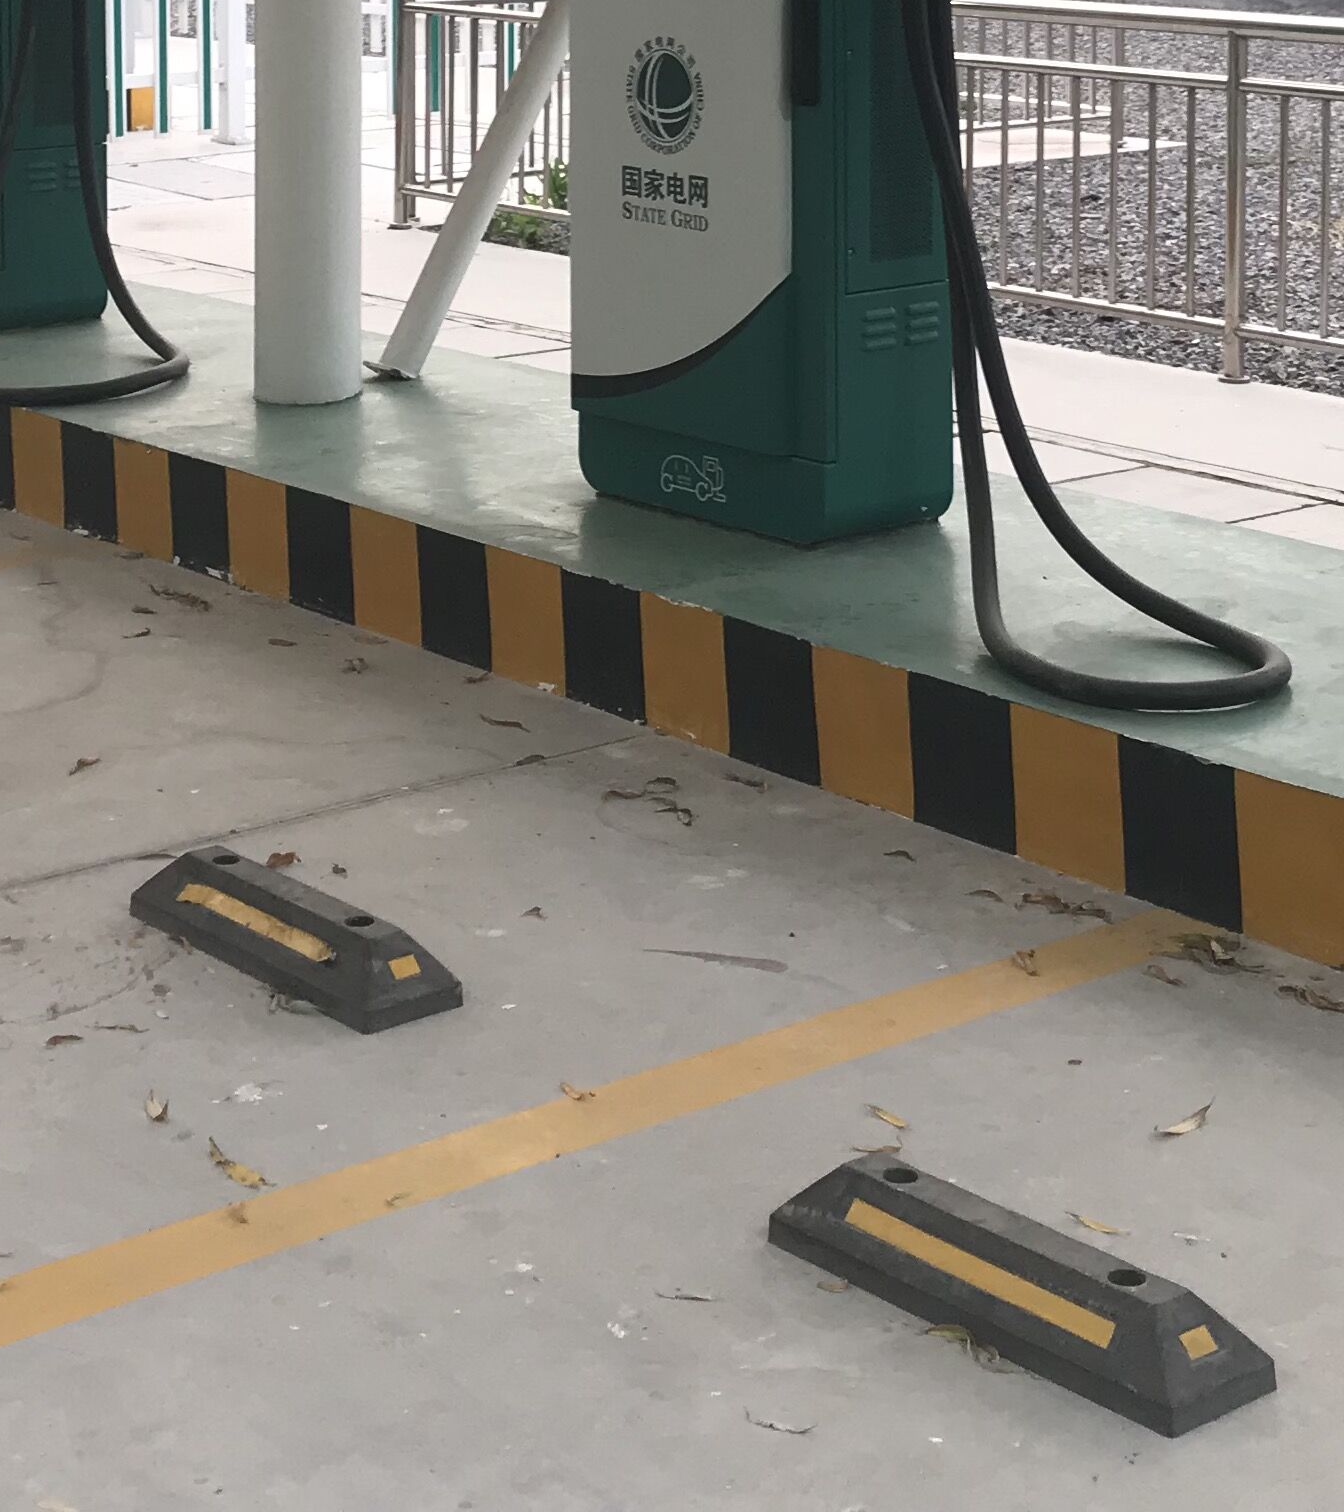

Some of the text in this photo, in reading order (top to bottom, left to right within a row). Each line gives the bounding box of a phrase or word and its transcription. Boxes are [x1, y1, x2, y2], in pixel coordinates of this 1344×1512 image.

[622, 165, 709, 209] 国家电网
[622, 201, 709, 232] STATE GRID
